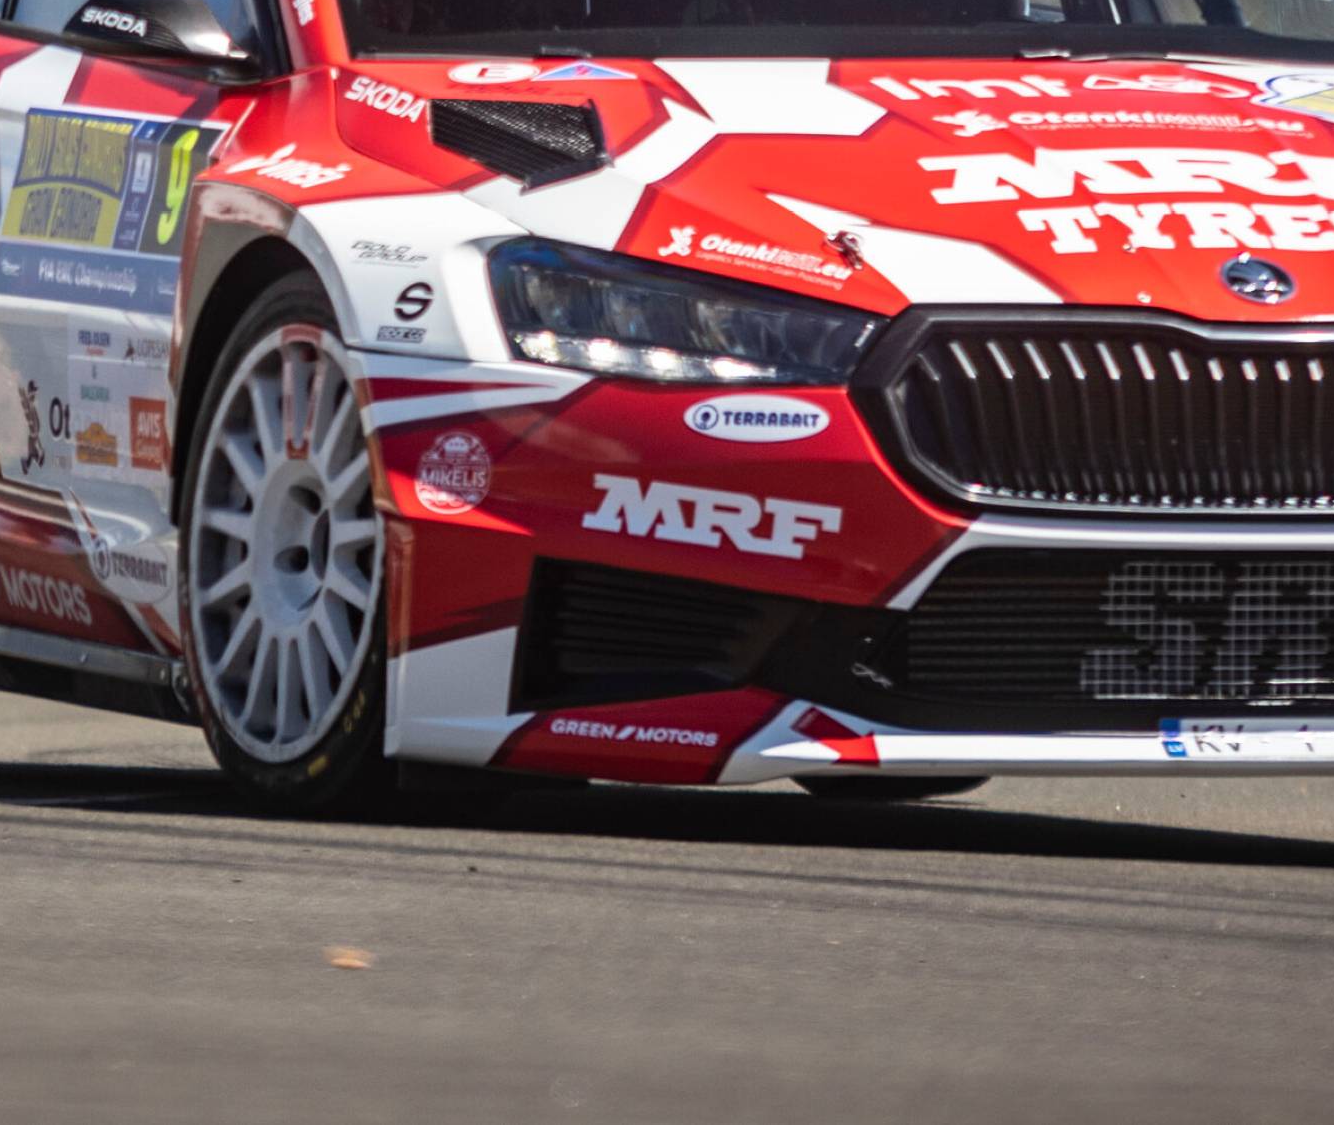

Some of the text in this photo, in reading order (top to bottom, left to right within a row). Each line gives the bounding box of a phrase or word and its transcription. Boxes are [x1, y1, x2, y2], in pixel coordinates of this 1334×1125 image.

[723, 409, 822, 431] TERRABALT
[582, 473, 842, 560] MRF
[0, 565, 93, 626] MOTORS
[550, 718, 718, 749] GREEN MOTORS
